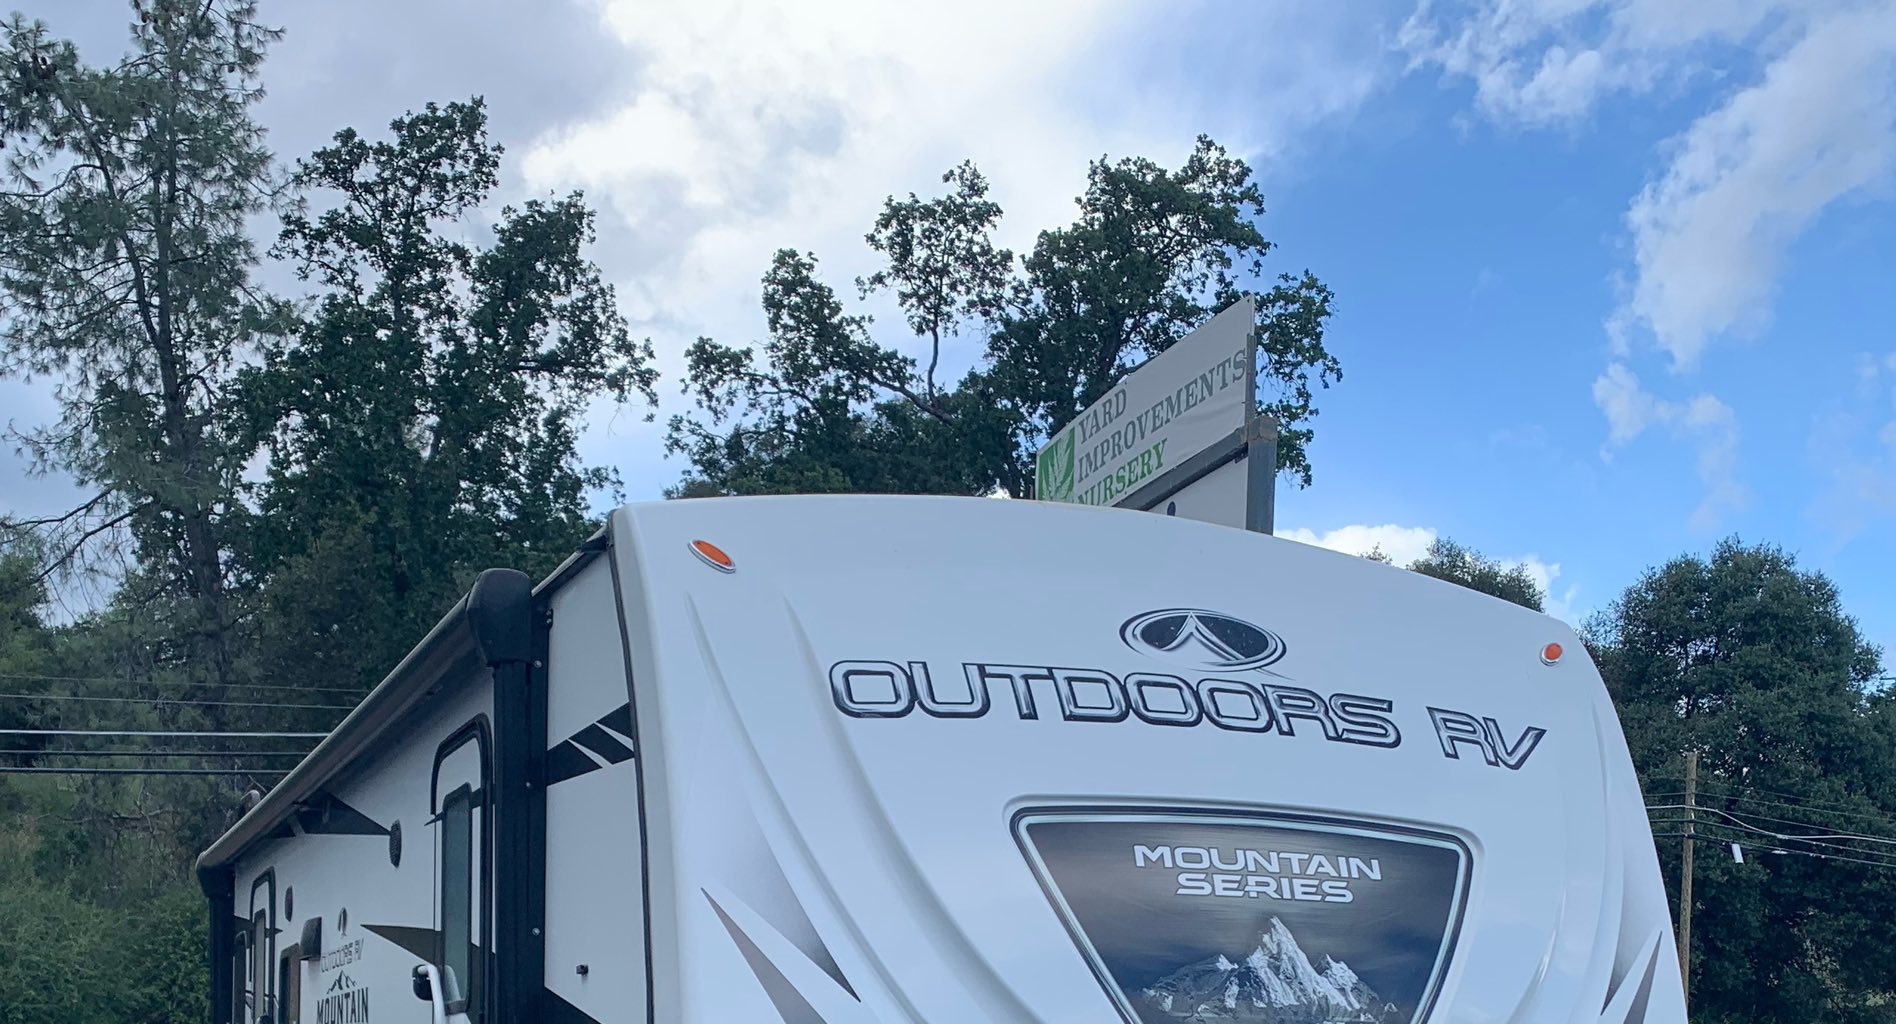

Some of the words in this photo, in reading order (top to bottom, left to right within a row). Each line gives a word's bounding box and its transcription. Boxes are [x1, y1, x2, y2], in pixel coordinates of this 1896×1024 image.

[1077, 346, 1248, 483] IMPROVEMENTS
[1078, 388, 1128, 445] YARD
[828, 658, 1403, 750] OUTDOORS
[1425, 705, 1547, 771] RV
[1133, 843, 1383, 882] MOUNTAIN
[1175, 871, 1356, 904] SERIES
